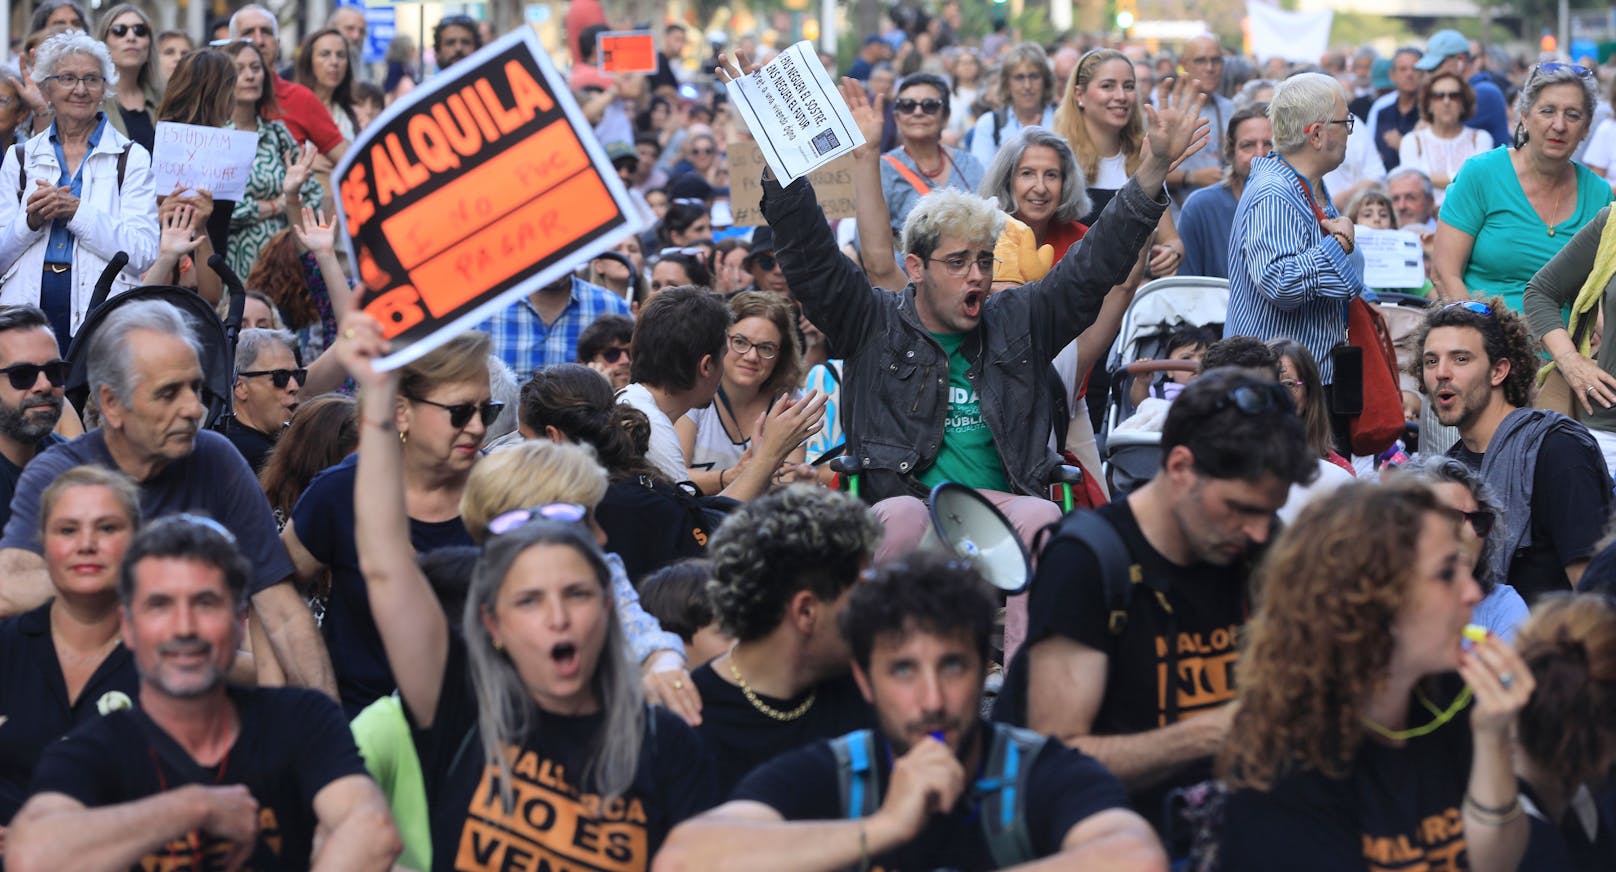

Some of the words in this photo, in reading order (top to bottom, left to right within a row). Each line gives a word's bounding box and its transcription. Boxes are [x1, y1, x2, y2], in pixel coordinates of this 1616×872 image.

[766, 64, 778, 79] ENS
[773, 75, 794, 104] NEGUEN
[788, 100, 798, 112] EL
[793, 106, 811, 130] FUTUR
[780, 55, 792, 70] ENS
[786, 67, 807, 94] NEGUEN
[800, 90, 811, 103] EL
[371, 59, 554, 206] ALQUILA
[485, 774, 557, 832] NO
[572, 814, 634, 864] ES
